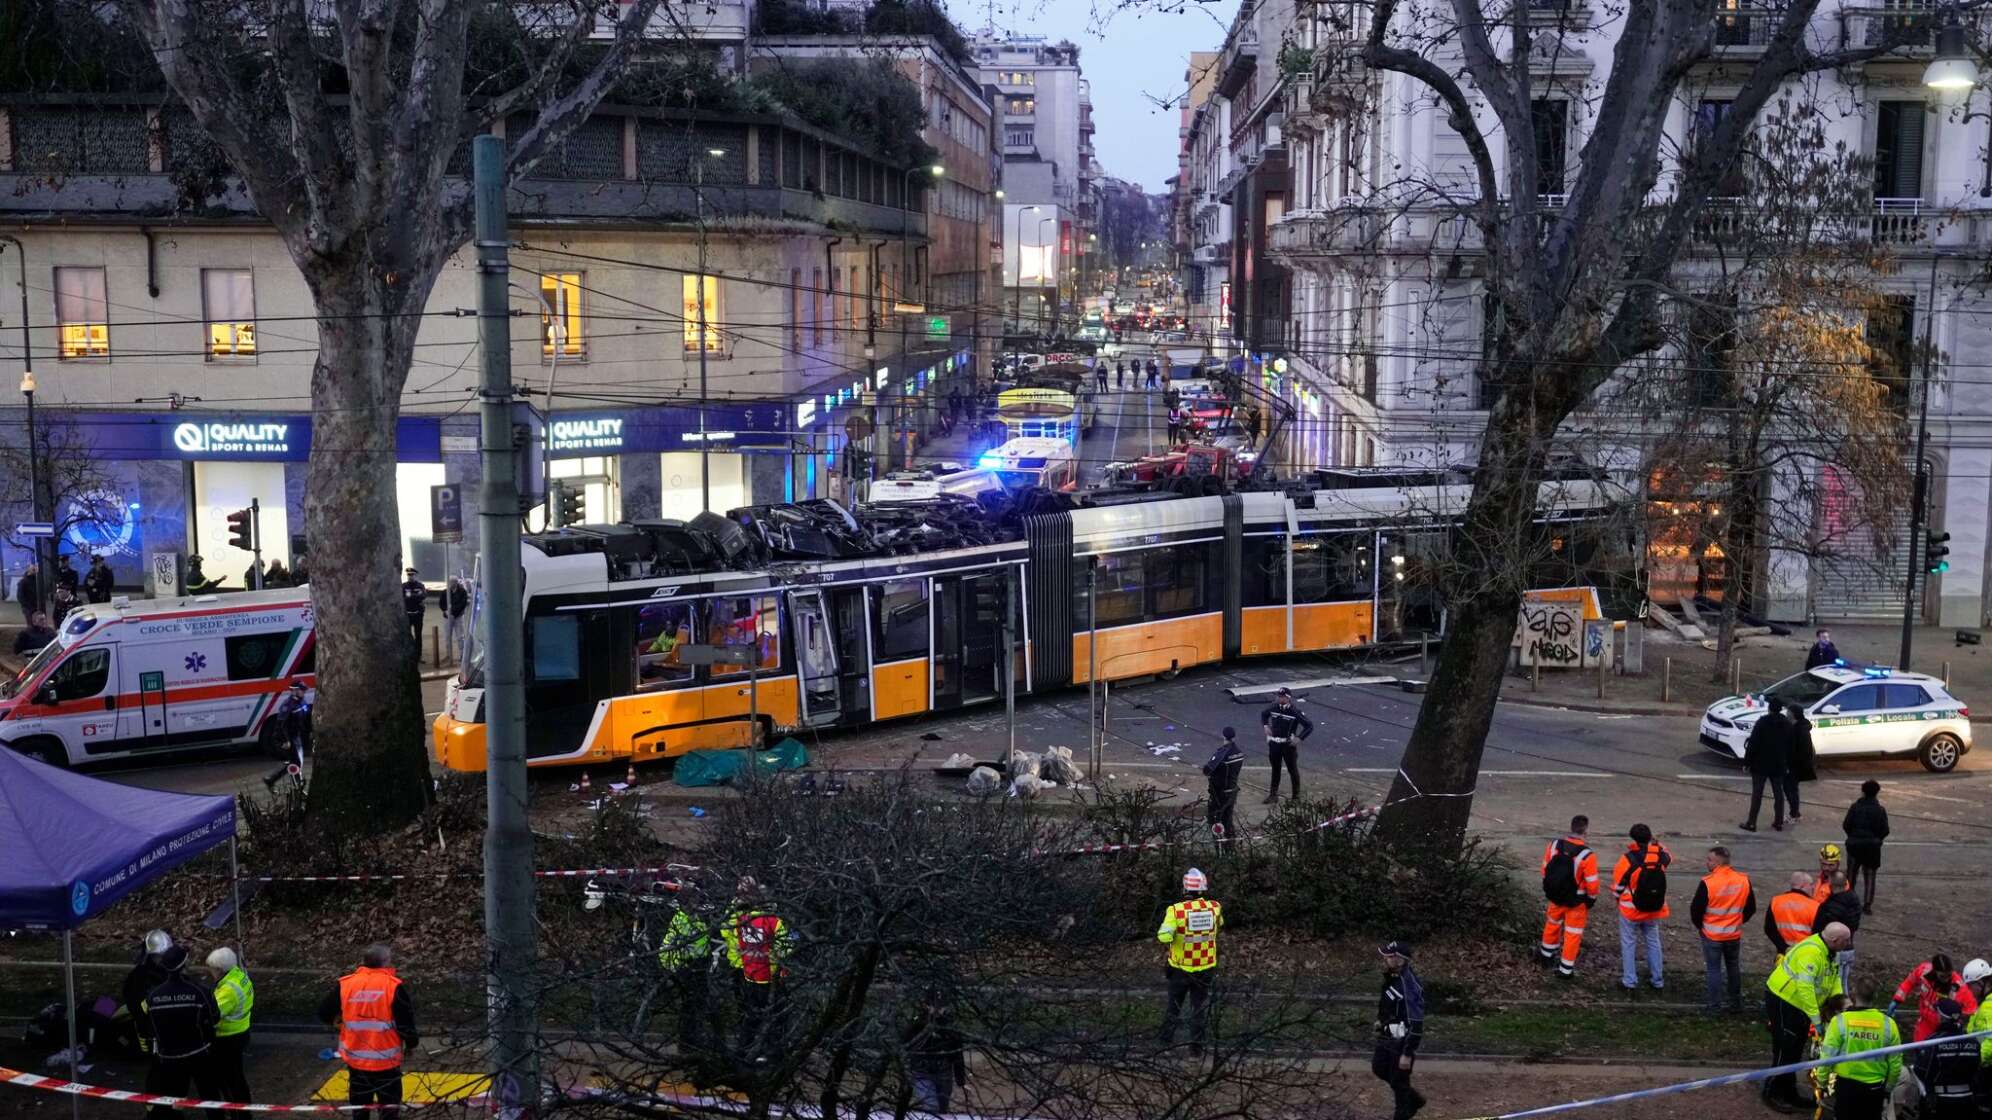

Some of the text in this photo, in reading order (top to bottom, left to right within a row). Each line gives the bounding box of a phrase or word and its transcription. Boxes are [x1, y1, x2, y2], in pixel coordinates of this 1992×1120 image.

[210, 423, 288, 442] QUALITY
[554, 419, 622, 440] QUALITY
[211, 443, 288, 452] SPORT & REHAB
[555, 439, 583, 449] SPORT
[593, 437, 622, 447] REHAB
[438, 487, 454, 510] P
[140, 614, 285, 635] CROCE VERDE SEMPIONE
[1830, 713, 1916, 726] Polizia Locale
[94, 811, 233, 895] COMUNE DI MILANO PROTEZIONE CIVILE
